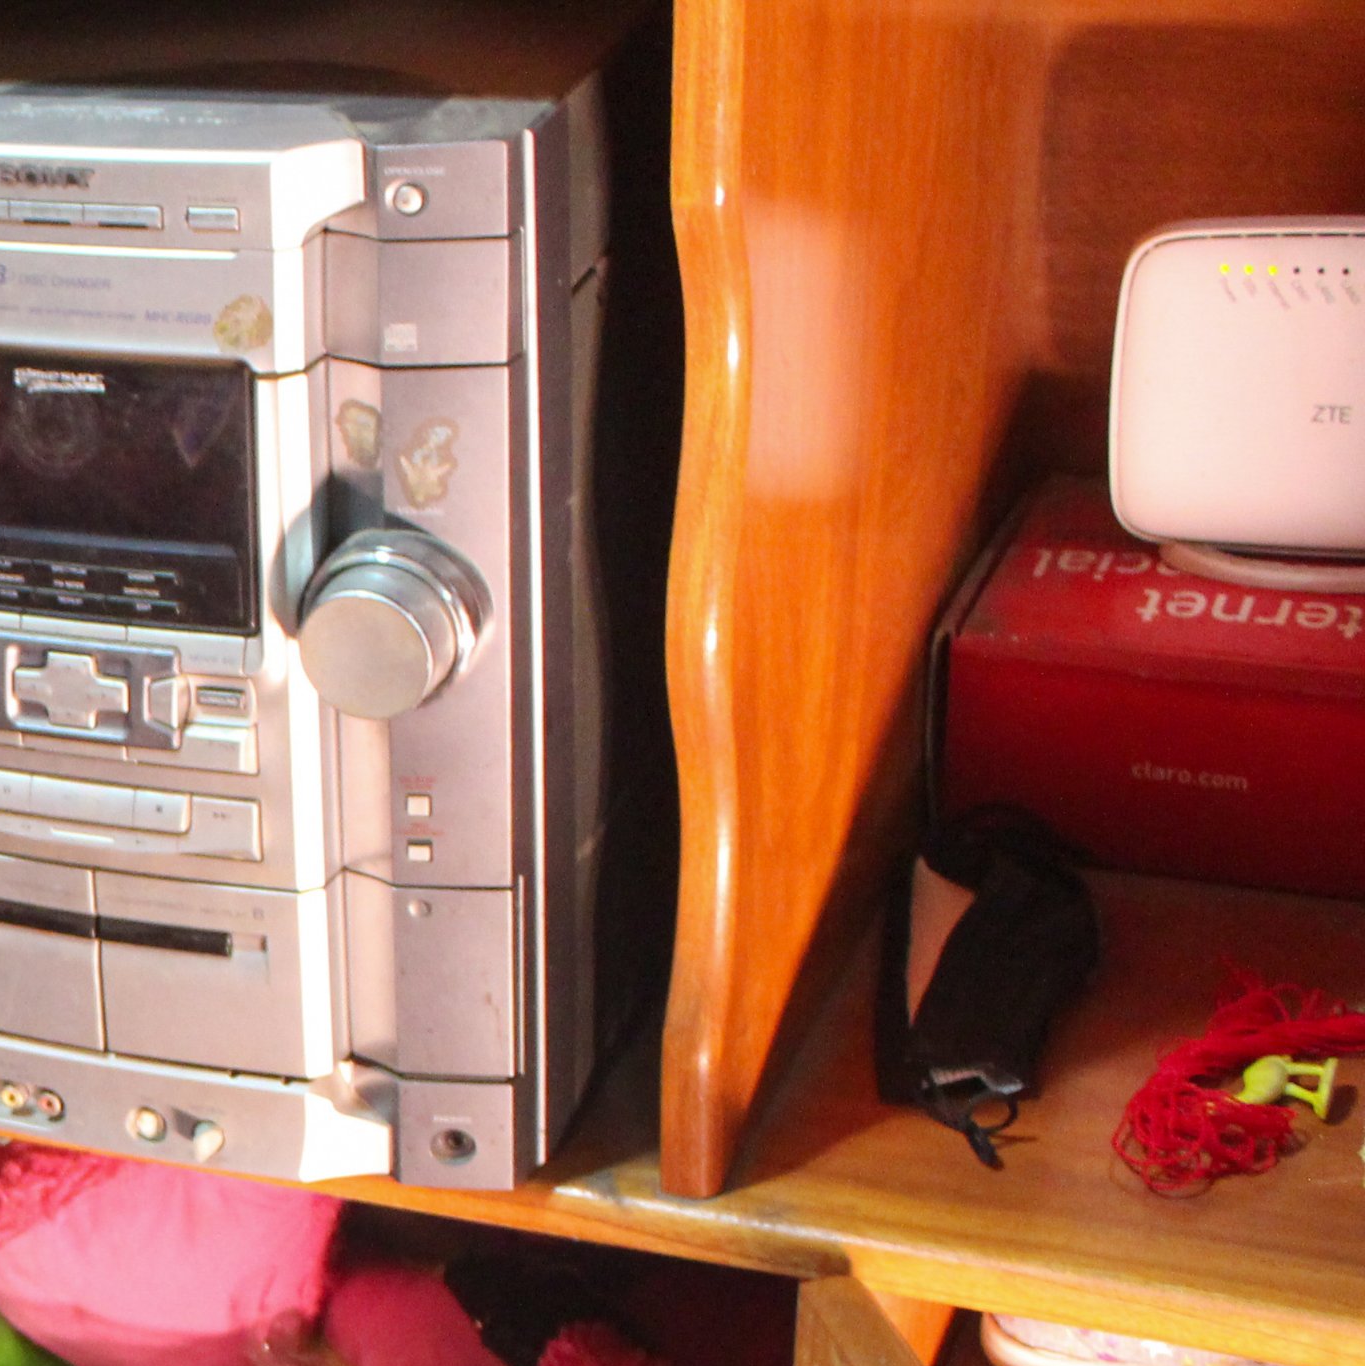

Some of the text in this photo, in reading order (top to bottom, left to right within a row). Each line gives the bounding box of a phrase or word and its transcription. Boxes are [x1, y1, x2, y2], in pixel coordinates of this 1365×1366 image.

[1312, 405, 1352, 423] ZTE
[1136, 588, 1363, 638] ternet
[1131, 761, 1247, 790] claro.com
